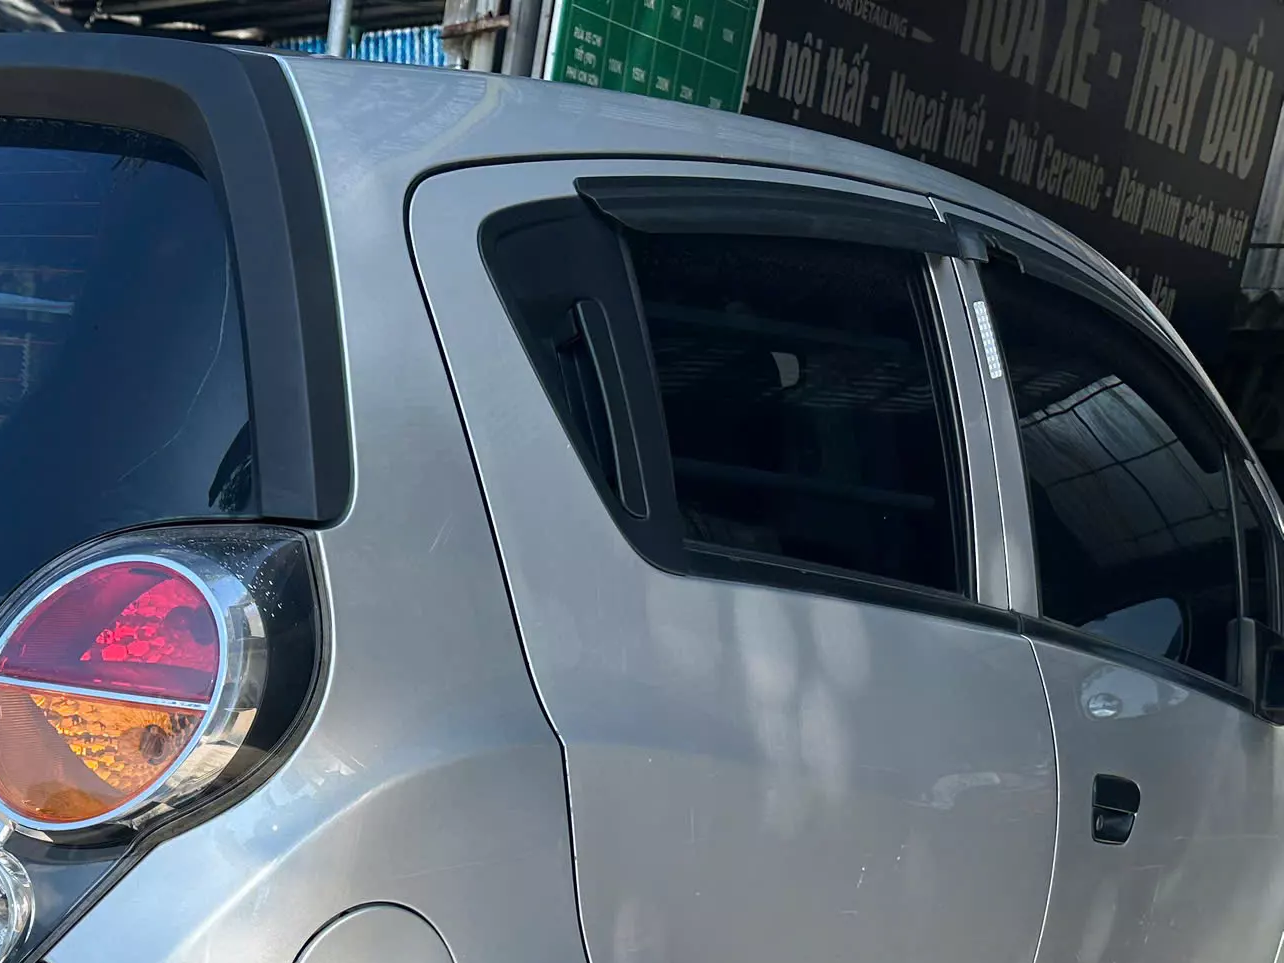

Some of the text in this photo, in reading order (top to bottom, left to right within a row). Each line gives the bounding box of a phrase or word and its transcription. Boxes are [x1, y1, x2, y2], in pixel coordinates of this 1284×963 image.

[853, 0, 909, 38] DETAILING
[1044, 0, 1109, 110] XE
[1124, 1, 1215, 155] THAY
[778, 32, 824, 121] nội
[821, 43, 871, 128] thất
[881, 70, 948, 161] Ngoại
[944, 93, 987, 168] thất
[999, 117, 1040, 186] Phủ
[1036, 133, 1106, 211] Ceramic
[1111, 165, 1146, 227] Dán
[1139, 181, 1183, 238] phim
[1178, 194, 1216, 250] cách
